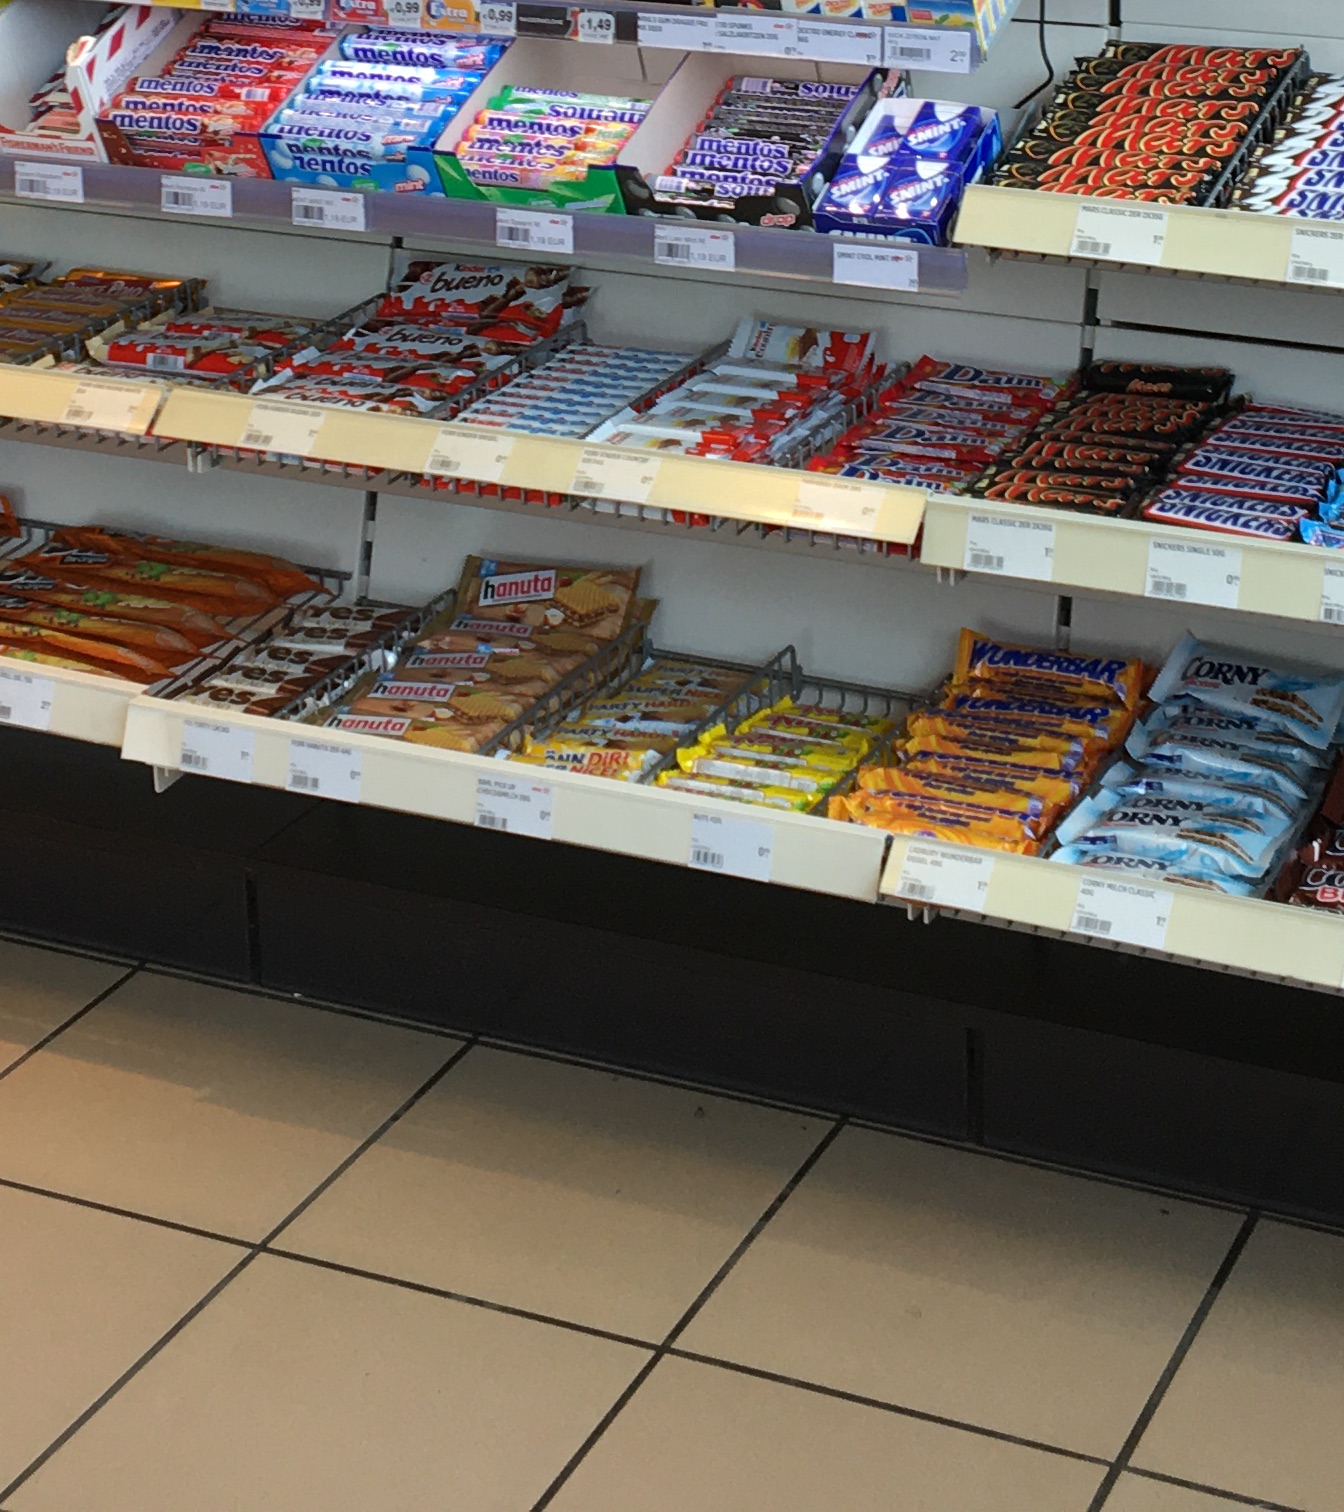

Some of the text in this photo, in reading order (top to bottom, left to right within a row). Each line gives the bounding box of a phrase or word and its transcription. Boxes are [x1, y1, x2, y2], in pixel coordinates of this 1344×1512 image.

[353, 45, 446, 67] mentos
[136, 77, 218, 95] mentos
[111, 111, 203, 134] mentos
[487, 115, 585, 138] mentos
[695, 135, 789, 159] mentos
[830, 171, 890, 199] SMINT
[888, 174, 950, 205] SMINT
[429, 269, 504, 292] bueno
[386, 325, 463, 346] bueno
[950, 365, 1044, 388] Daim
[483, 573, 553, 600] hanuta
[971, 638, 1128, 682] WUNDERBAR
[1182, 655, 1269, 686] CORNY
[327, 716, 406, 734] hanuta
